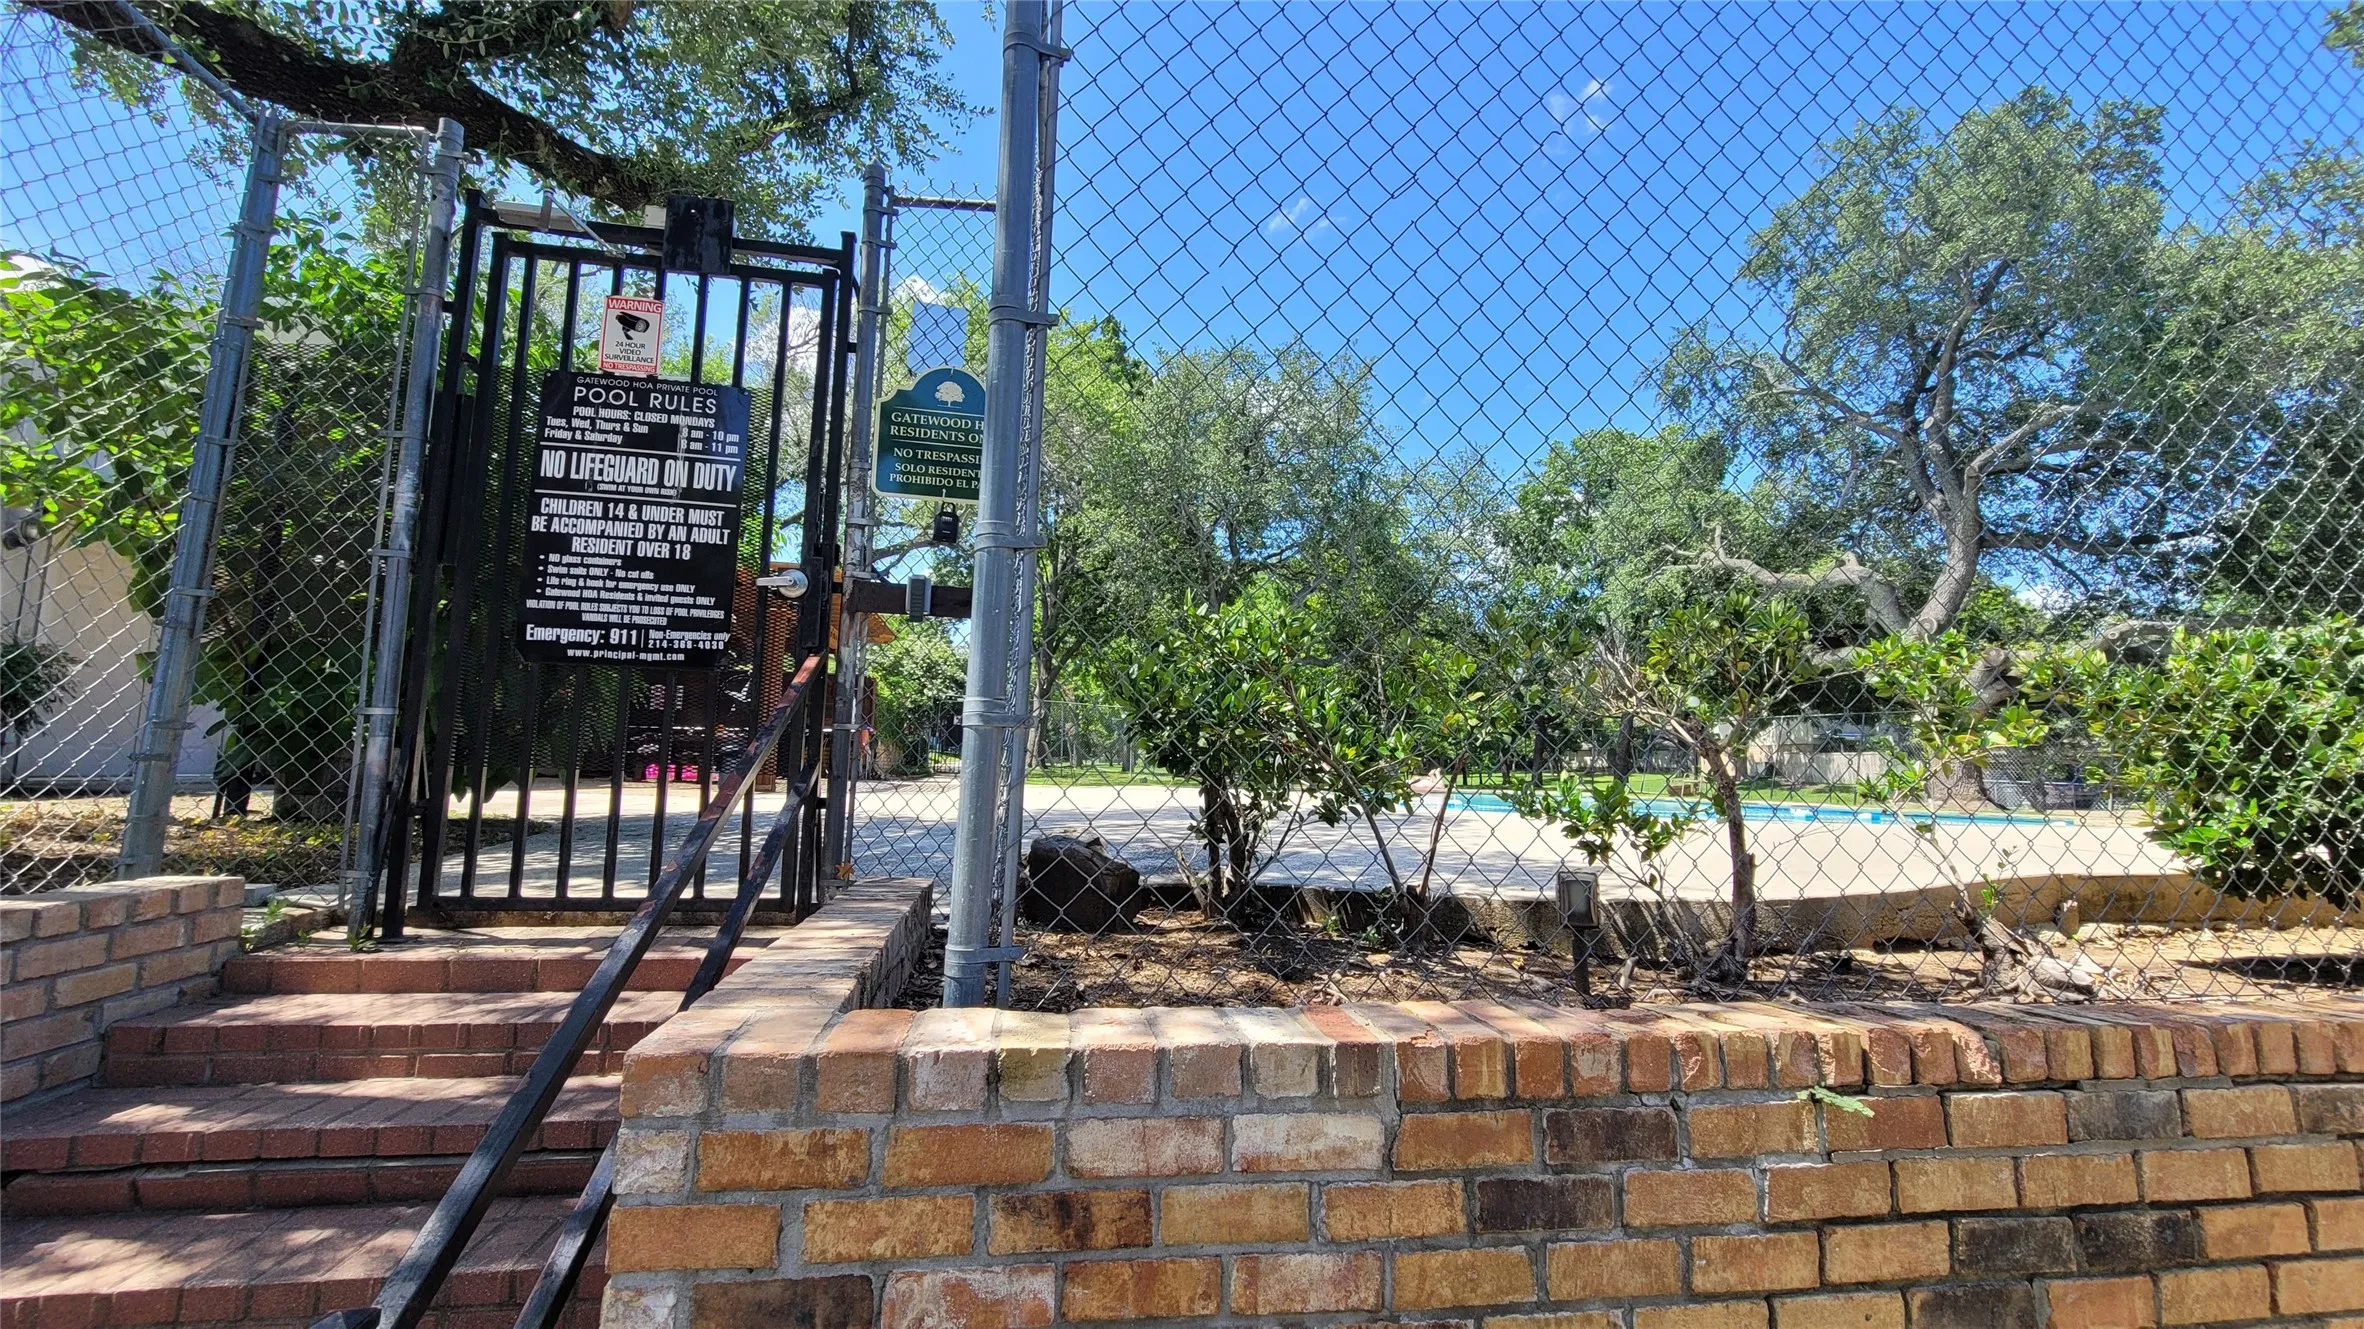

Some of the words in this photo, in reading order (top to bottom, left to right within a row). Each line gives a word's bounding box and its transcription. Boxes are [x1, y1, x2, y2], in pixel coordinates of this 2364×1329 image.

[608, 299, 662, 313] WARNING
[604, 354, 654, 363] SURVEILLANCE
[615, 363, 656, 372] TRESPASSING
[576, 376, 630, 387] GATEWOOD
[633, 381, 653, 389] HOA
[656, 383, 690, 393] PRIVATE
[693, 386, 718, 396] POOL
[574, 386, 638, 406] POOL
[649, 392, 716, 414] RULES
[546, 416, 569, 428] Tues,
[572, 418, 592, 430] Wed,
[596, 420, 621, 431] Thurs
[623, 422, 630, 432] &
[632, 422, 648, 434] Sun
[573, 406, 596, 417] POOL
[599, 408, 632, 420] HOURS:
[634, 411, 668, 423] CLOSED
[670, 414, 715, 428] MONDAYS
[891, 412, 971, 429] GATEWOOD
[975, 421, 984, 430] H
[544, 428, 573, 440] Friday
[575, 430, 582, 440] &
[584, 430, 623, 444] Saturday
[682, 427, 688, 437] 8
[690, 430, 704, 438] am
[713, 431, 724, 441] 10
[726, 433, 739, 442] pm
[890, 425, 965, 442] RESIDENTS
[968, 434, 983, 443] O
[681, 439, 687, 449] 8
[690, 441, 702, 450] am
[712, 442, 722, 452] 11
[725, 445, 738, 454] pm
[894, 448, 912, 458] NO
[916, 449, 981, 464] TRESPASSI
[540, 450, 567, 478] NO
[570, 452, 660, 485] LIFEGUARD
[664, 459, 689, 488] ON
[693, 462, 736, 492] DUTY
[895, 463, 925, 473] SOLO
[928, 465, 981, 478] RESIDENT
[889, 474, 953, 487] PROHIBIDO
[957, 480, 968, 488] EL
[597, 483, 617, 491] (SWIM
[661, 488, 677, 496] RISK)
[540, 498, 603, 517] CHILDREN
[608, 502, 624, 518] 14
[628, 504, 638, 520] &
[642, 505, 684, 524] UNDER
[688, 509, 725, 526] MUST
[531, 515, 547, 532] BE
[550, 517, 644, 538] ACCOMPANIED
[648, 524, 665, 540] BY
[668, 525, 687, 542] AN
[690, 527, 730, 545] ADULT
[572, 537, 634, 556] RESIDENT
[637, 541, 670, 559] OVER
[674, 544, 691, 560] 18
[548, 553, 560, 562] NO
[562, 555, 581, 564] glass
[583, 557, 622, 566] containers
[548, 565, 568, 574] Swim
[570, 566, 587, 575] suits
[589, 567, 609, 576] ONLY
[615, 569, 626, 577] No
[640, 571, 654, 579] offs
[546, 576, 559, 584] Life
[561, 577, 577, 587] ring
[578, 578, 584, 586] &
[586, 579, 603, 587] hook
[605, 580, 616, 588] for
[619, 581, 659, 592] emergency
[676, 584, 695, 593] ONLY
[545, 587, 580, 597] Gatewood
[582, 590, 598, 598] HOA
[600, 590, 635, 600] Residents
[637, 593, 643, 601] &
[645, 593, 668, 602] invited
[670, 596, 694, 604] guests
[696, 597, 715, 605] ONLY
[526, 599, 556, 609] VIOLATION
[557, 601, 564, 610] OF
[565, 601, 579, 610] POOL
[581, 602, 598, 611] RULES
[599, 603, 628, 613] SUBJECTS
[629, 605, 640, 614] YOU
[641, 606, 649, 614] TO
[650, 606, 665, 615] LOSS
[666, 607, 674, 616] OF
[674, 608, 689, 616] POOL
[582, 612, 608, 621] VANDALS
[609, 613, 622, 623] WILL
[623, 615, 631, 623] BE
[632, 616, 667, 625] PROSECUTED
[526, 624, 605, 645] Emergency:
[609, 628, 637, 645] 911
[649, 629, 712, 640] Non-Emergencies
[714, 632, 730, 642] only
[648, 640, 724, 649] 214-368-4030
[567, 649, 684, 661] www.principal-mgmt.com
